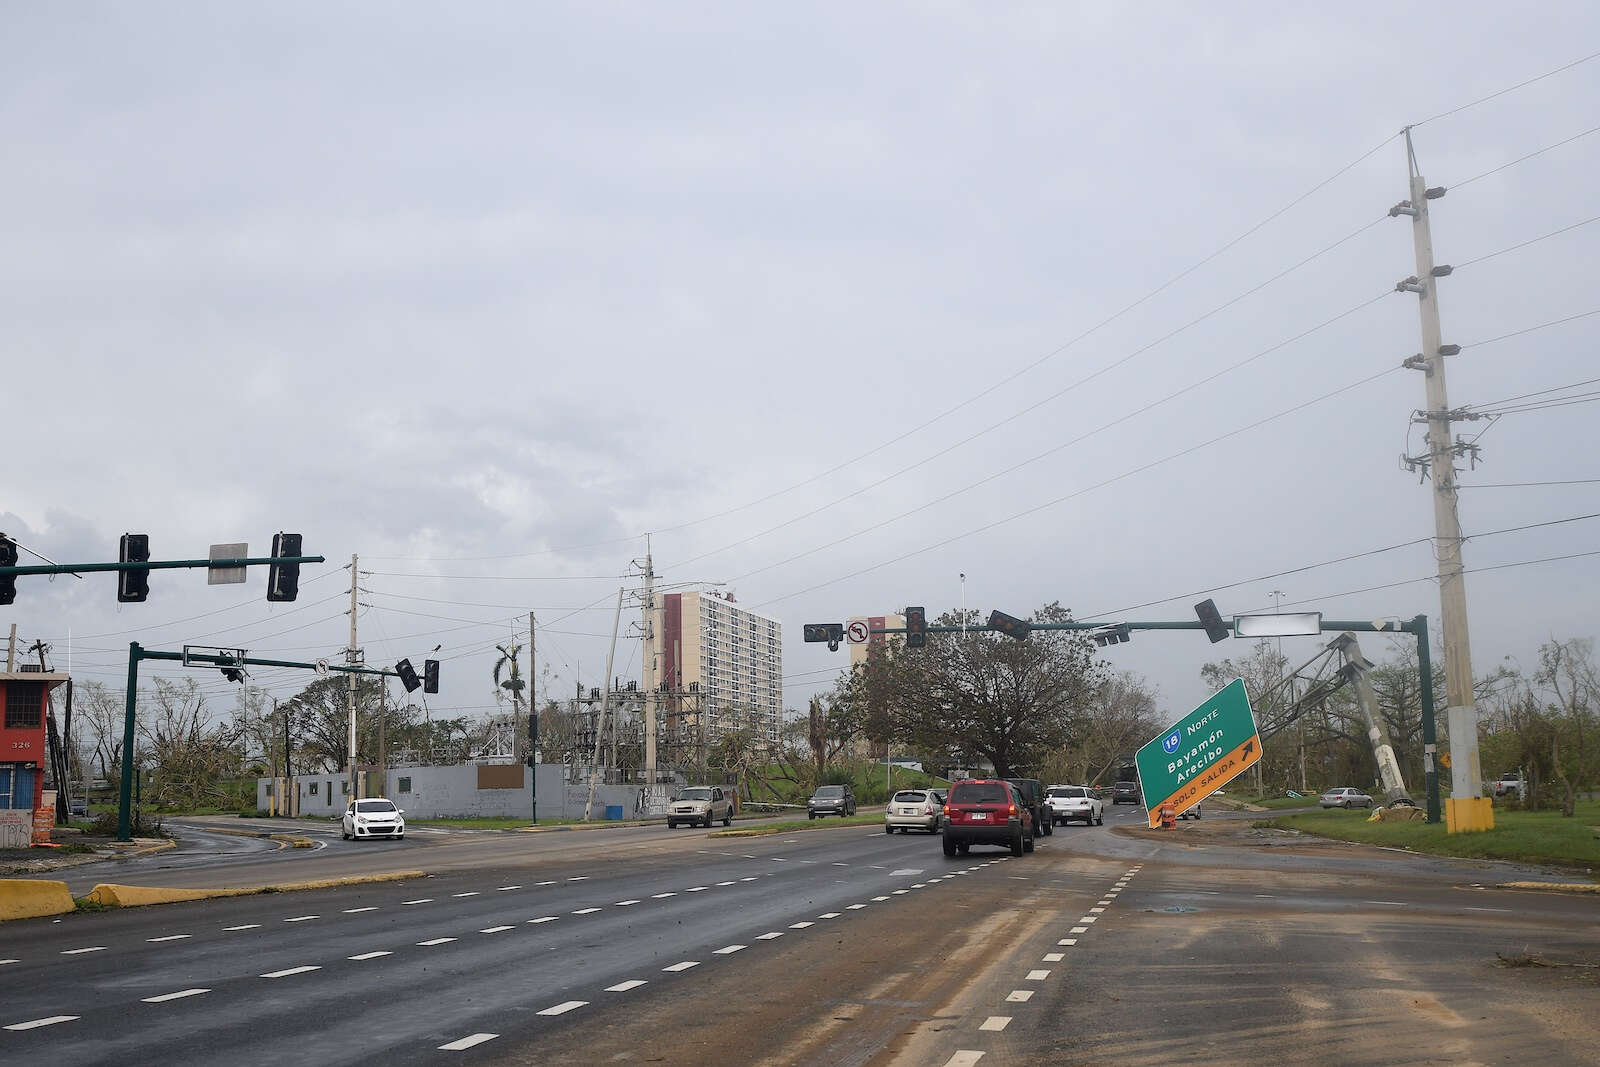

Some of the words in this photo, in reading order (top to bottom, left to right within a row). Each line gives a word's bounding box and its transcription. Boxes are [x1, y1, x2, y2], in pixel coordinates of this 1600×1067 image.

[1187, 709, 1219, 736] NORTE
[1166, 735, 1178, 749] 18
[1168, 729, 1223, 773] Bayamón
[1174, 787, 1196, 807] SOLO
[1201, 760, 1235, 787] SALIDA
[1177, 747, 1222, 784] Arecibo
